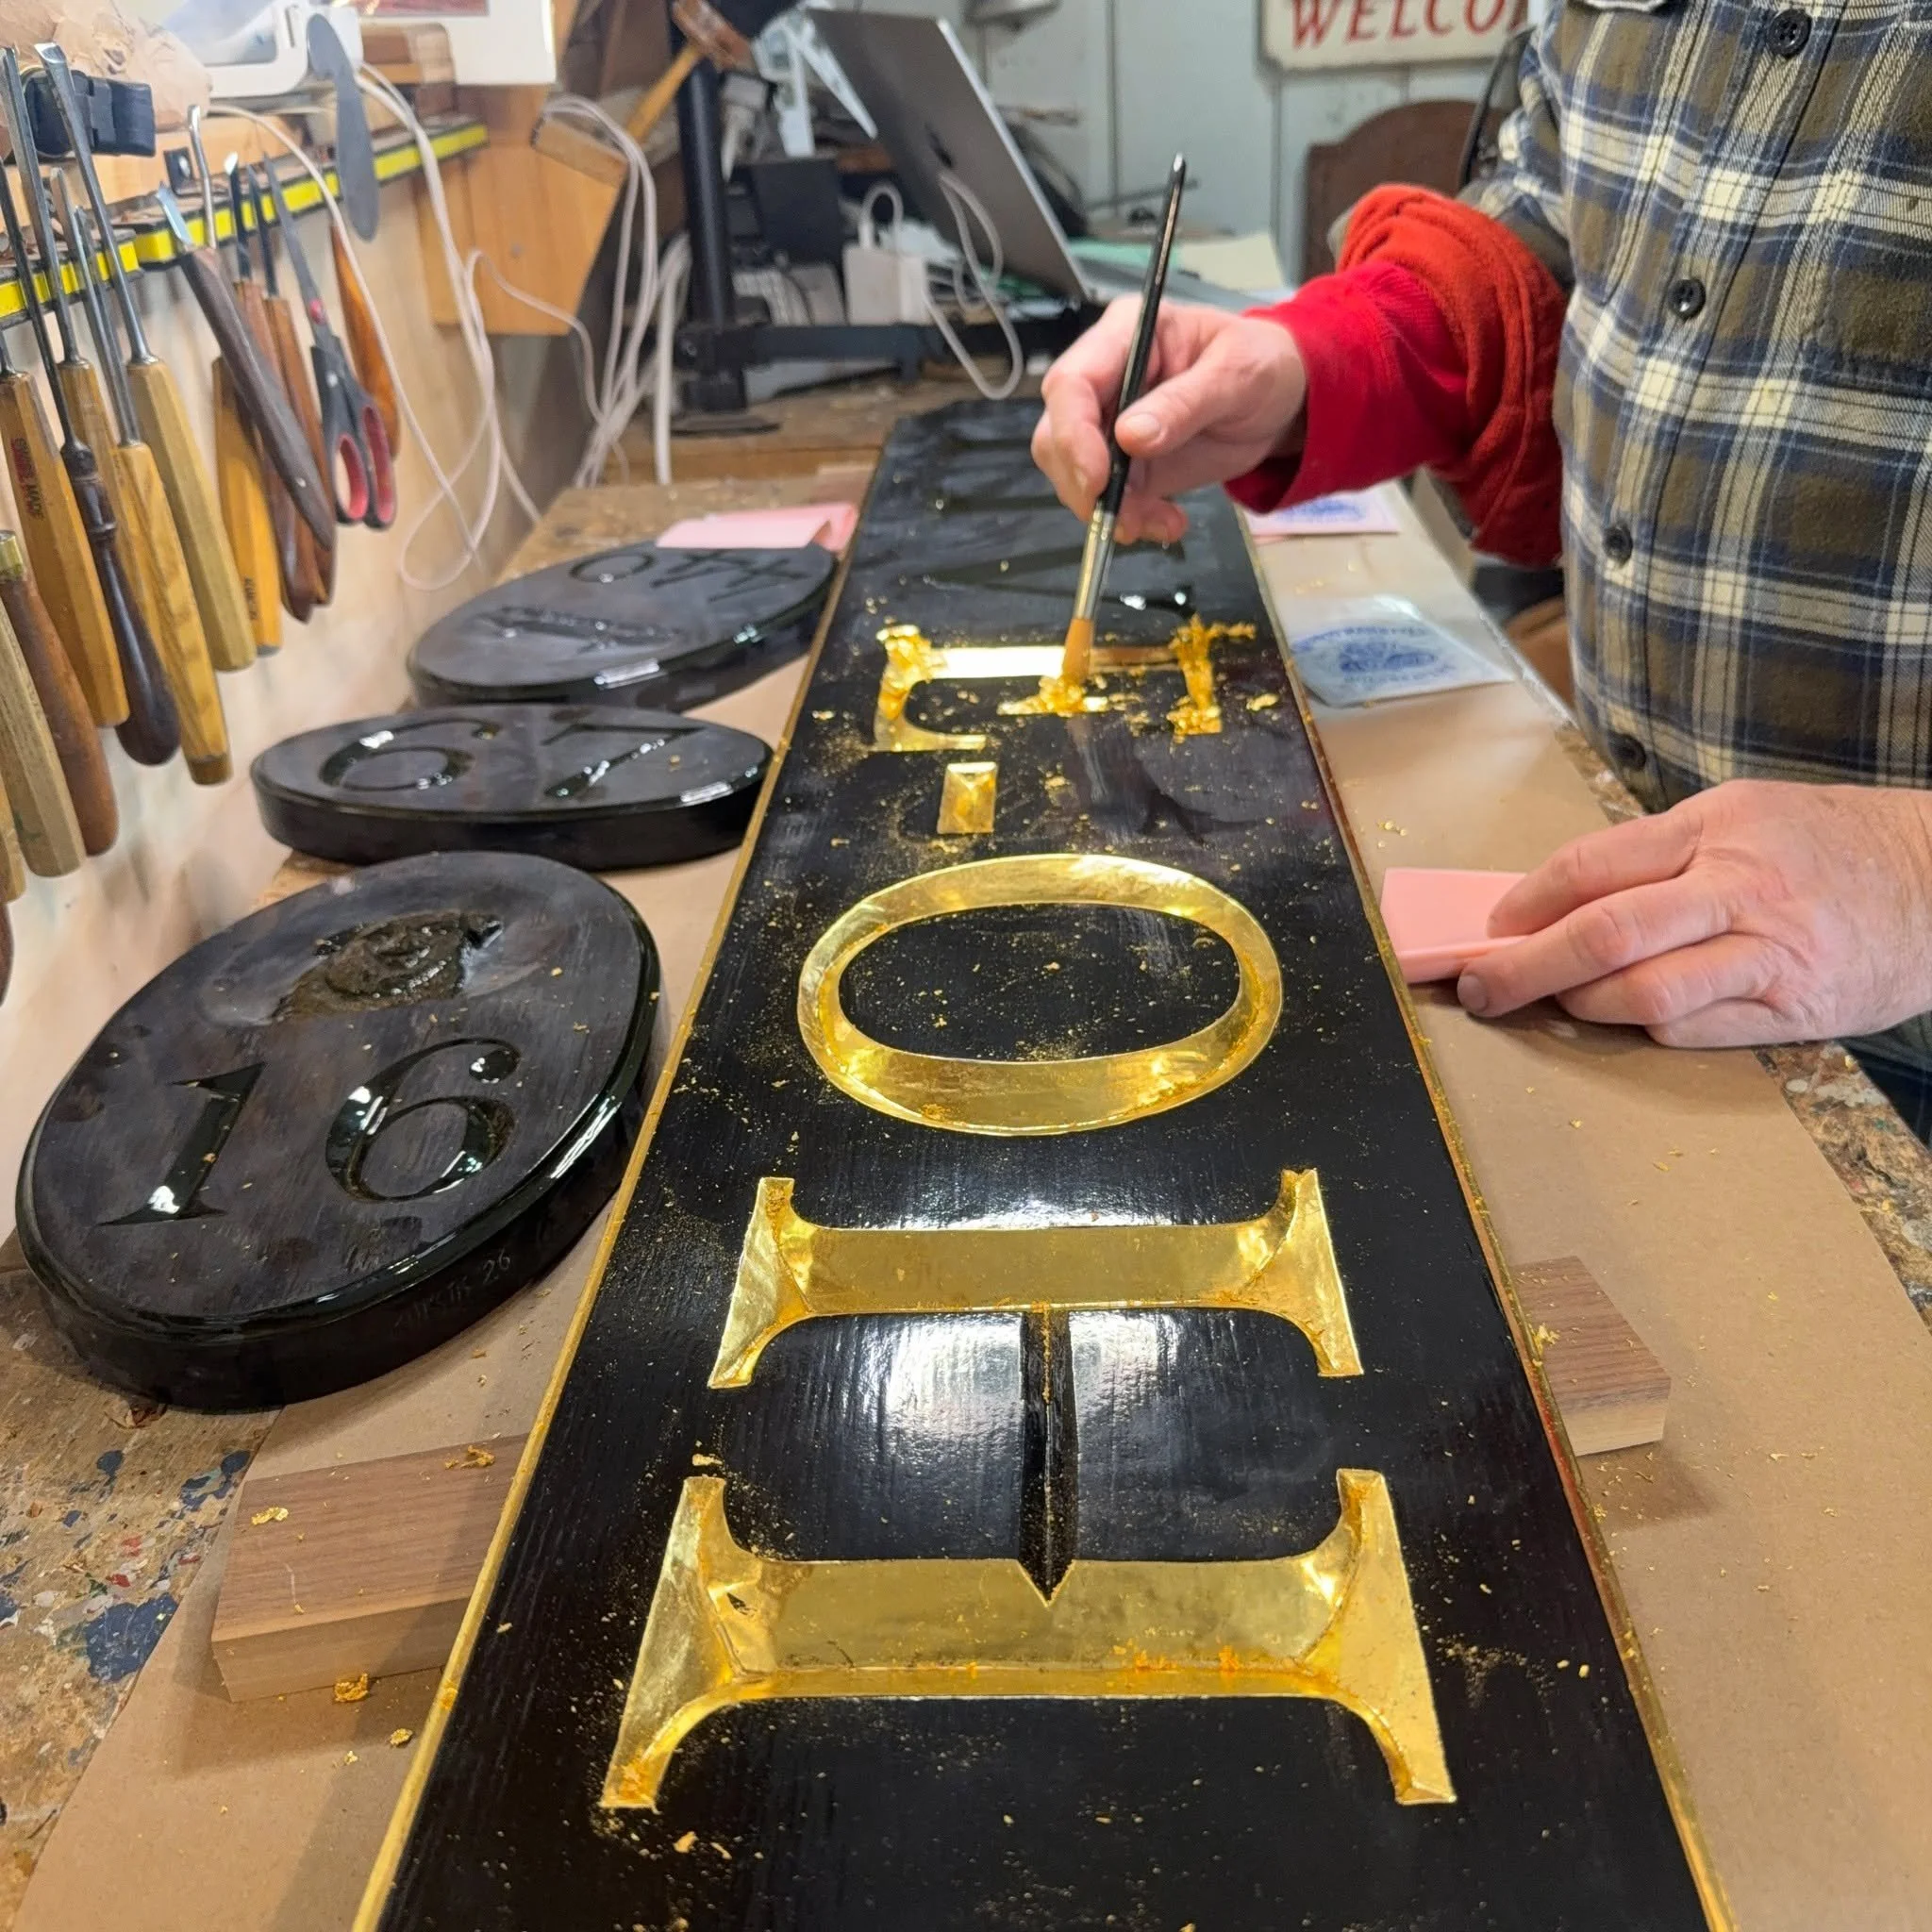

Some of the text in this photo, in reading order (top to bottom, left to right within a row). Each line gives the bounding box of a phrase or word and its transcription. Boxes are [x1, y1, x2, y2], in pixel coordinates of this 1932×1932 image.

[1290, 0, 1526, 48] WELCO
[318, 718, 708, 798] 67
[96, 1038, 521, 1226] 16
